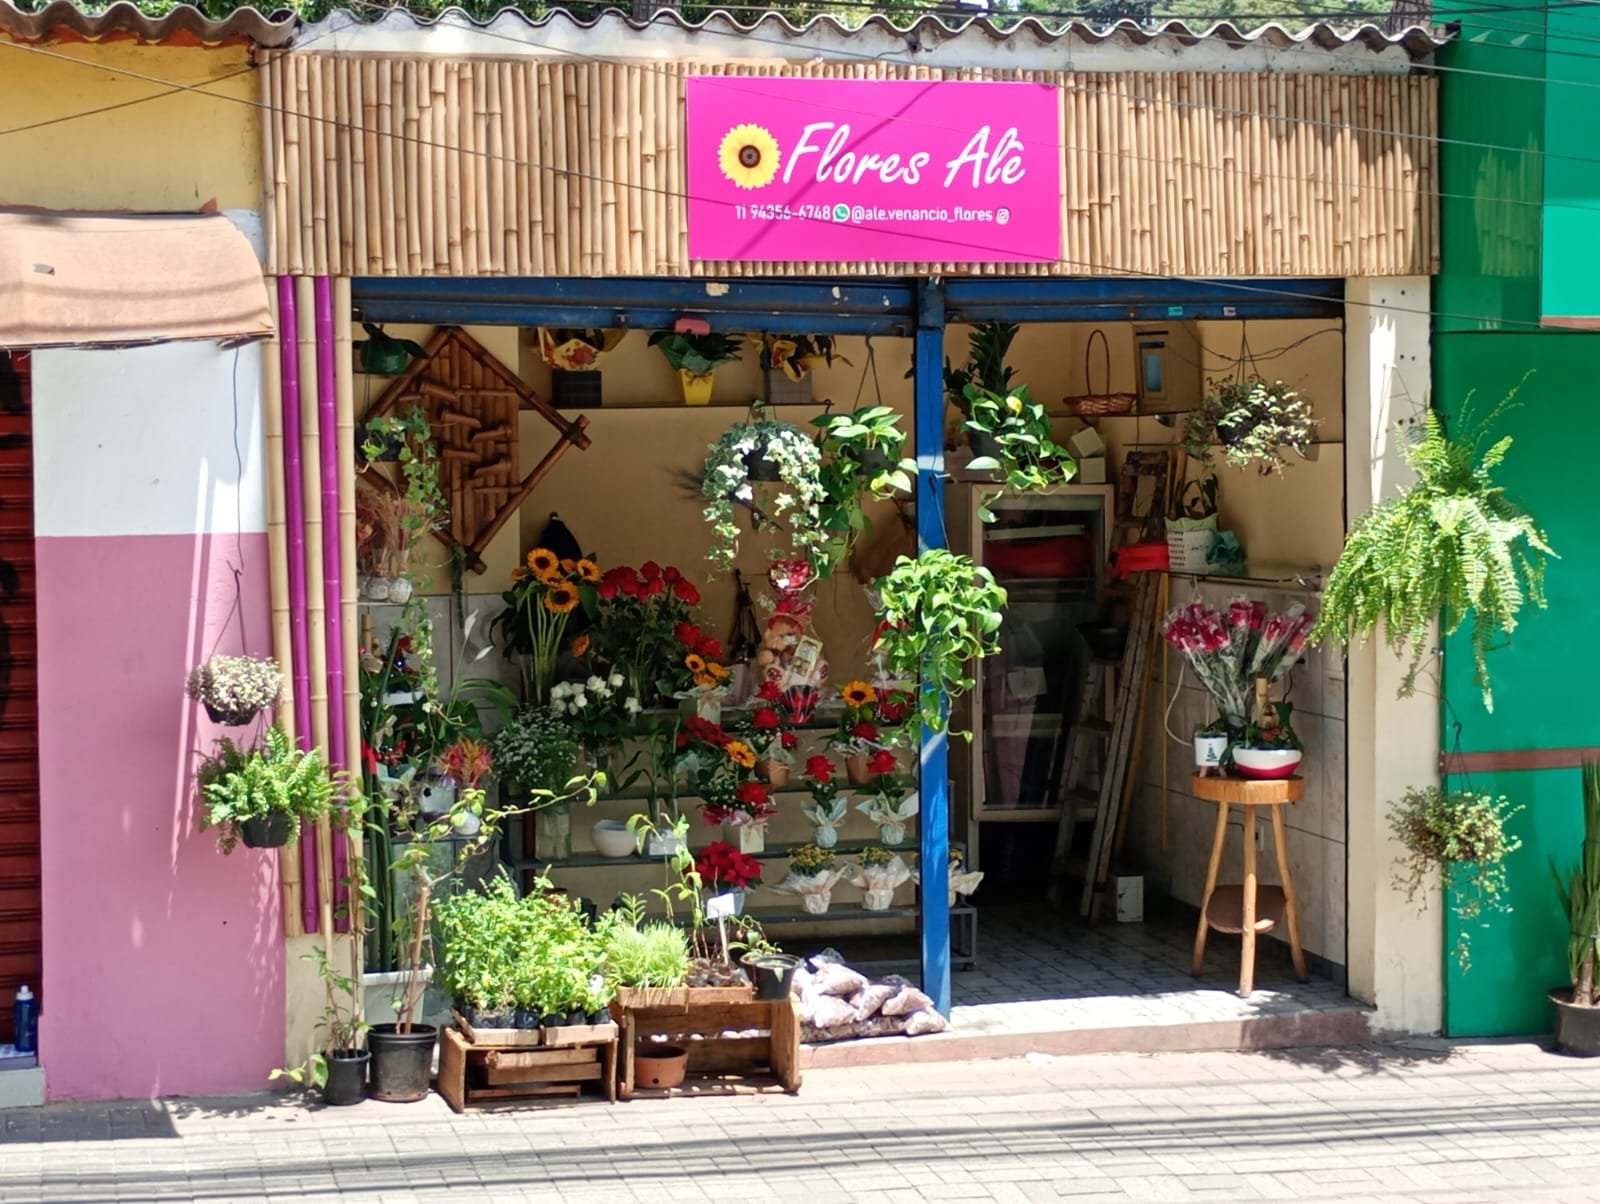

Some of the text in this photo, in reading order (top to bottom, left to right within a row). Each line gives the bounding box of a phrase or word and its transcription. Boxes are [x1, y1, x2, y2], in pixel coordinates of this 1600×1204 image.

[783, 121, 1026, 188] Flores Alê
[851, 205, 993, 224] @ale.venancio_flores
